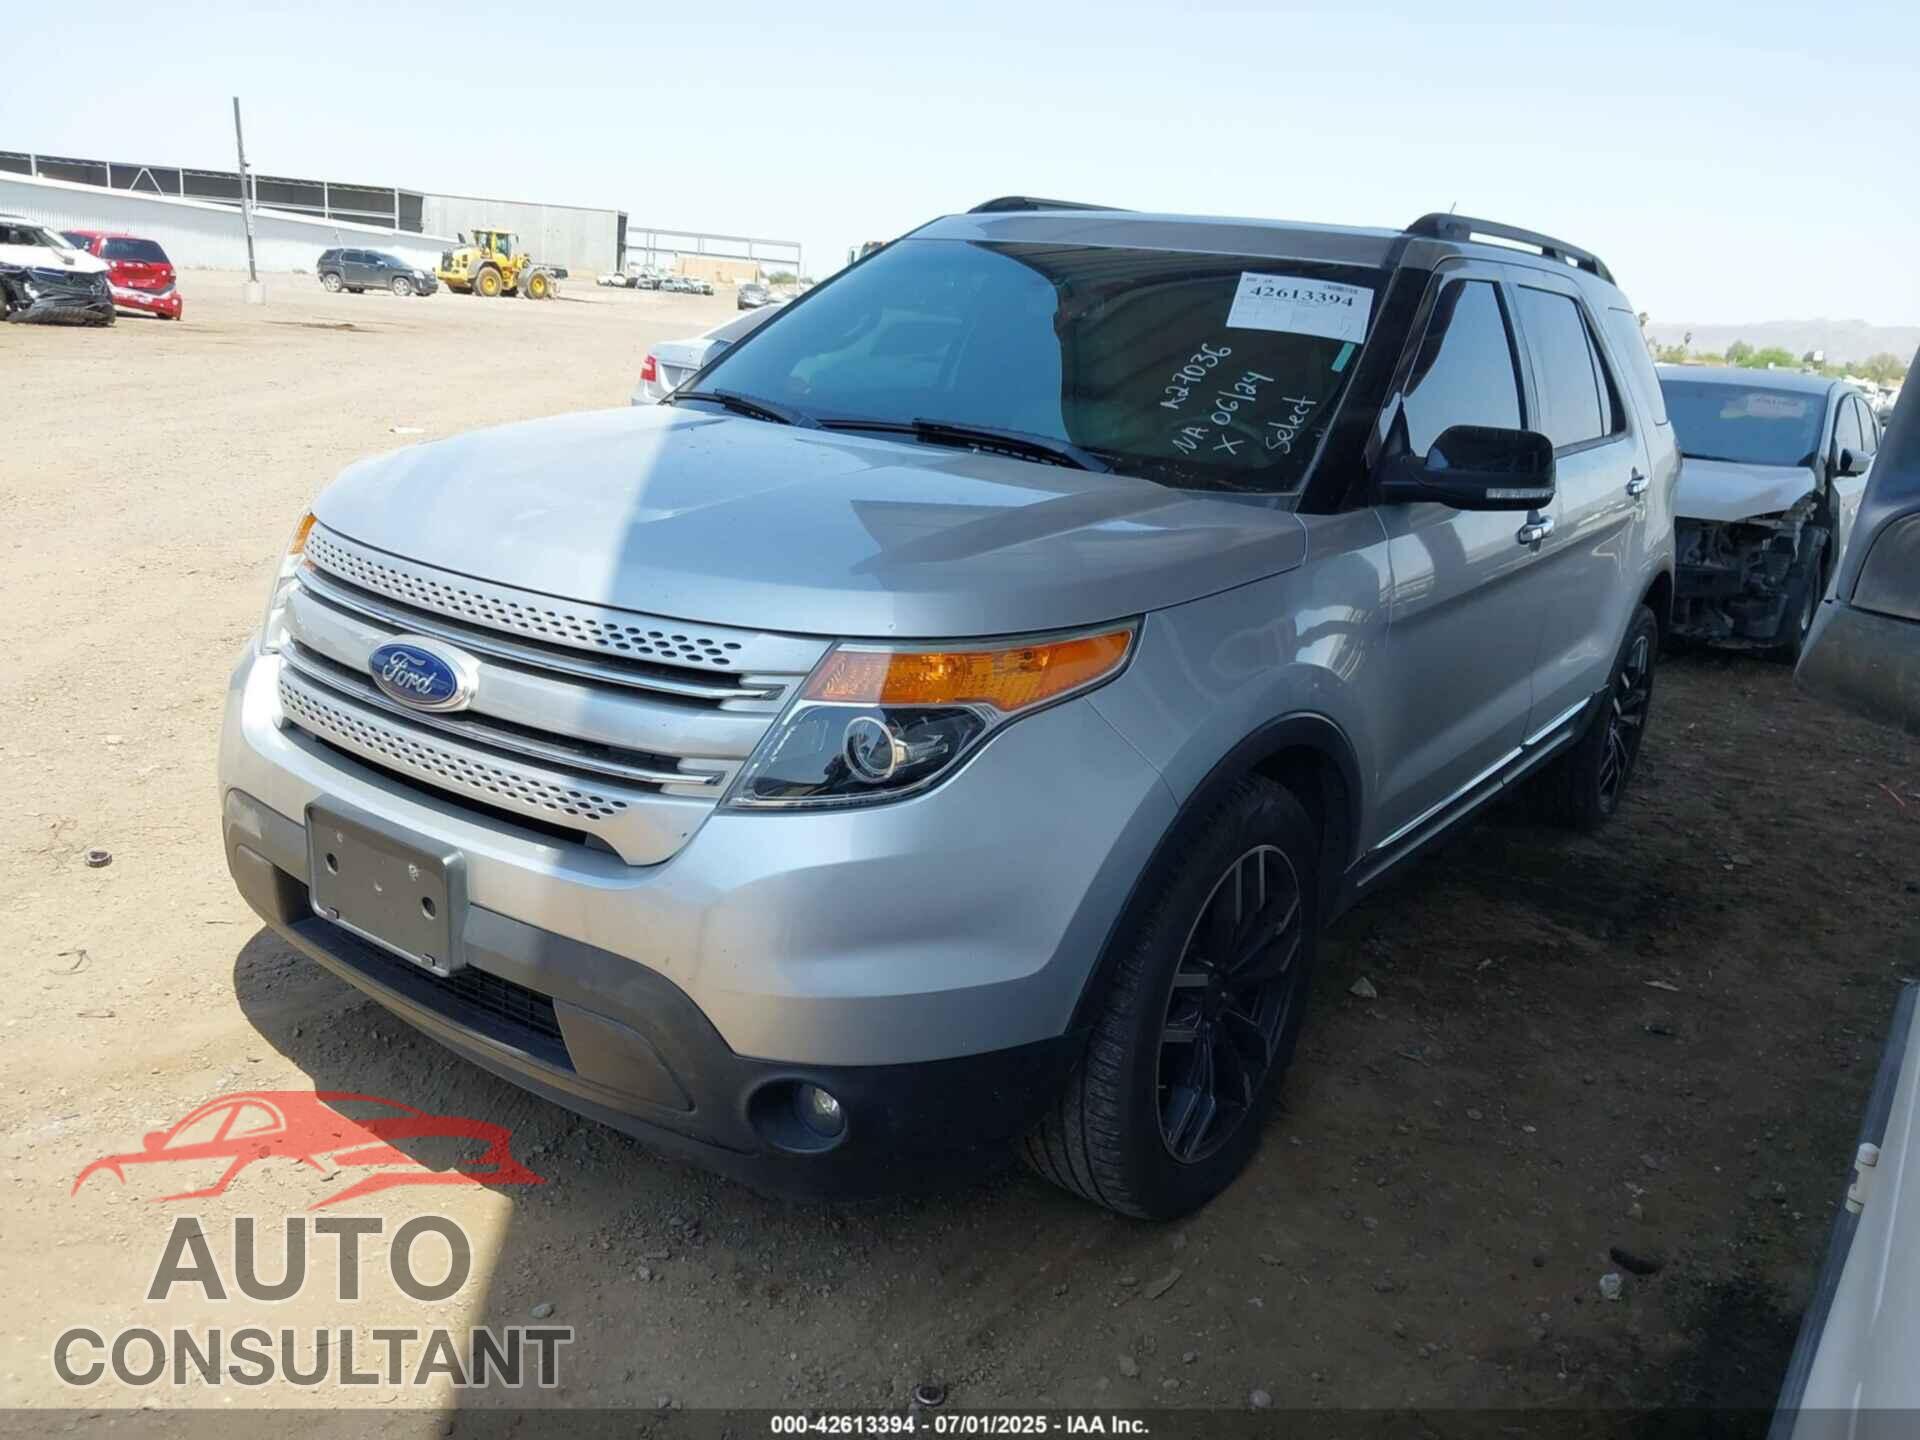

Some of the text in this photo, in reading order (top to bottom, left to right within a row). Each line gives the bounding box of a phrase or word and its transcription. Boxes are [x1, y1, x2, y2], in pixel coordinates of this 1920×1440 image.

[1249, 285, 1354, 307] 42613394
[1172, 371, 1275, 455] NA 06/24
[1266, 395, 1318, 455] Select
[1213, 434, 1246, 456] X
[382, 650, 438, 695] Ford
